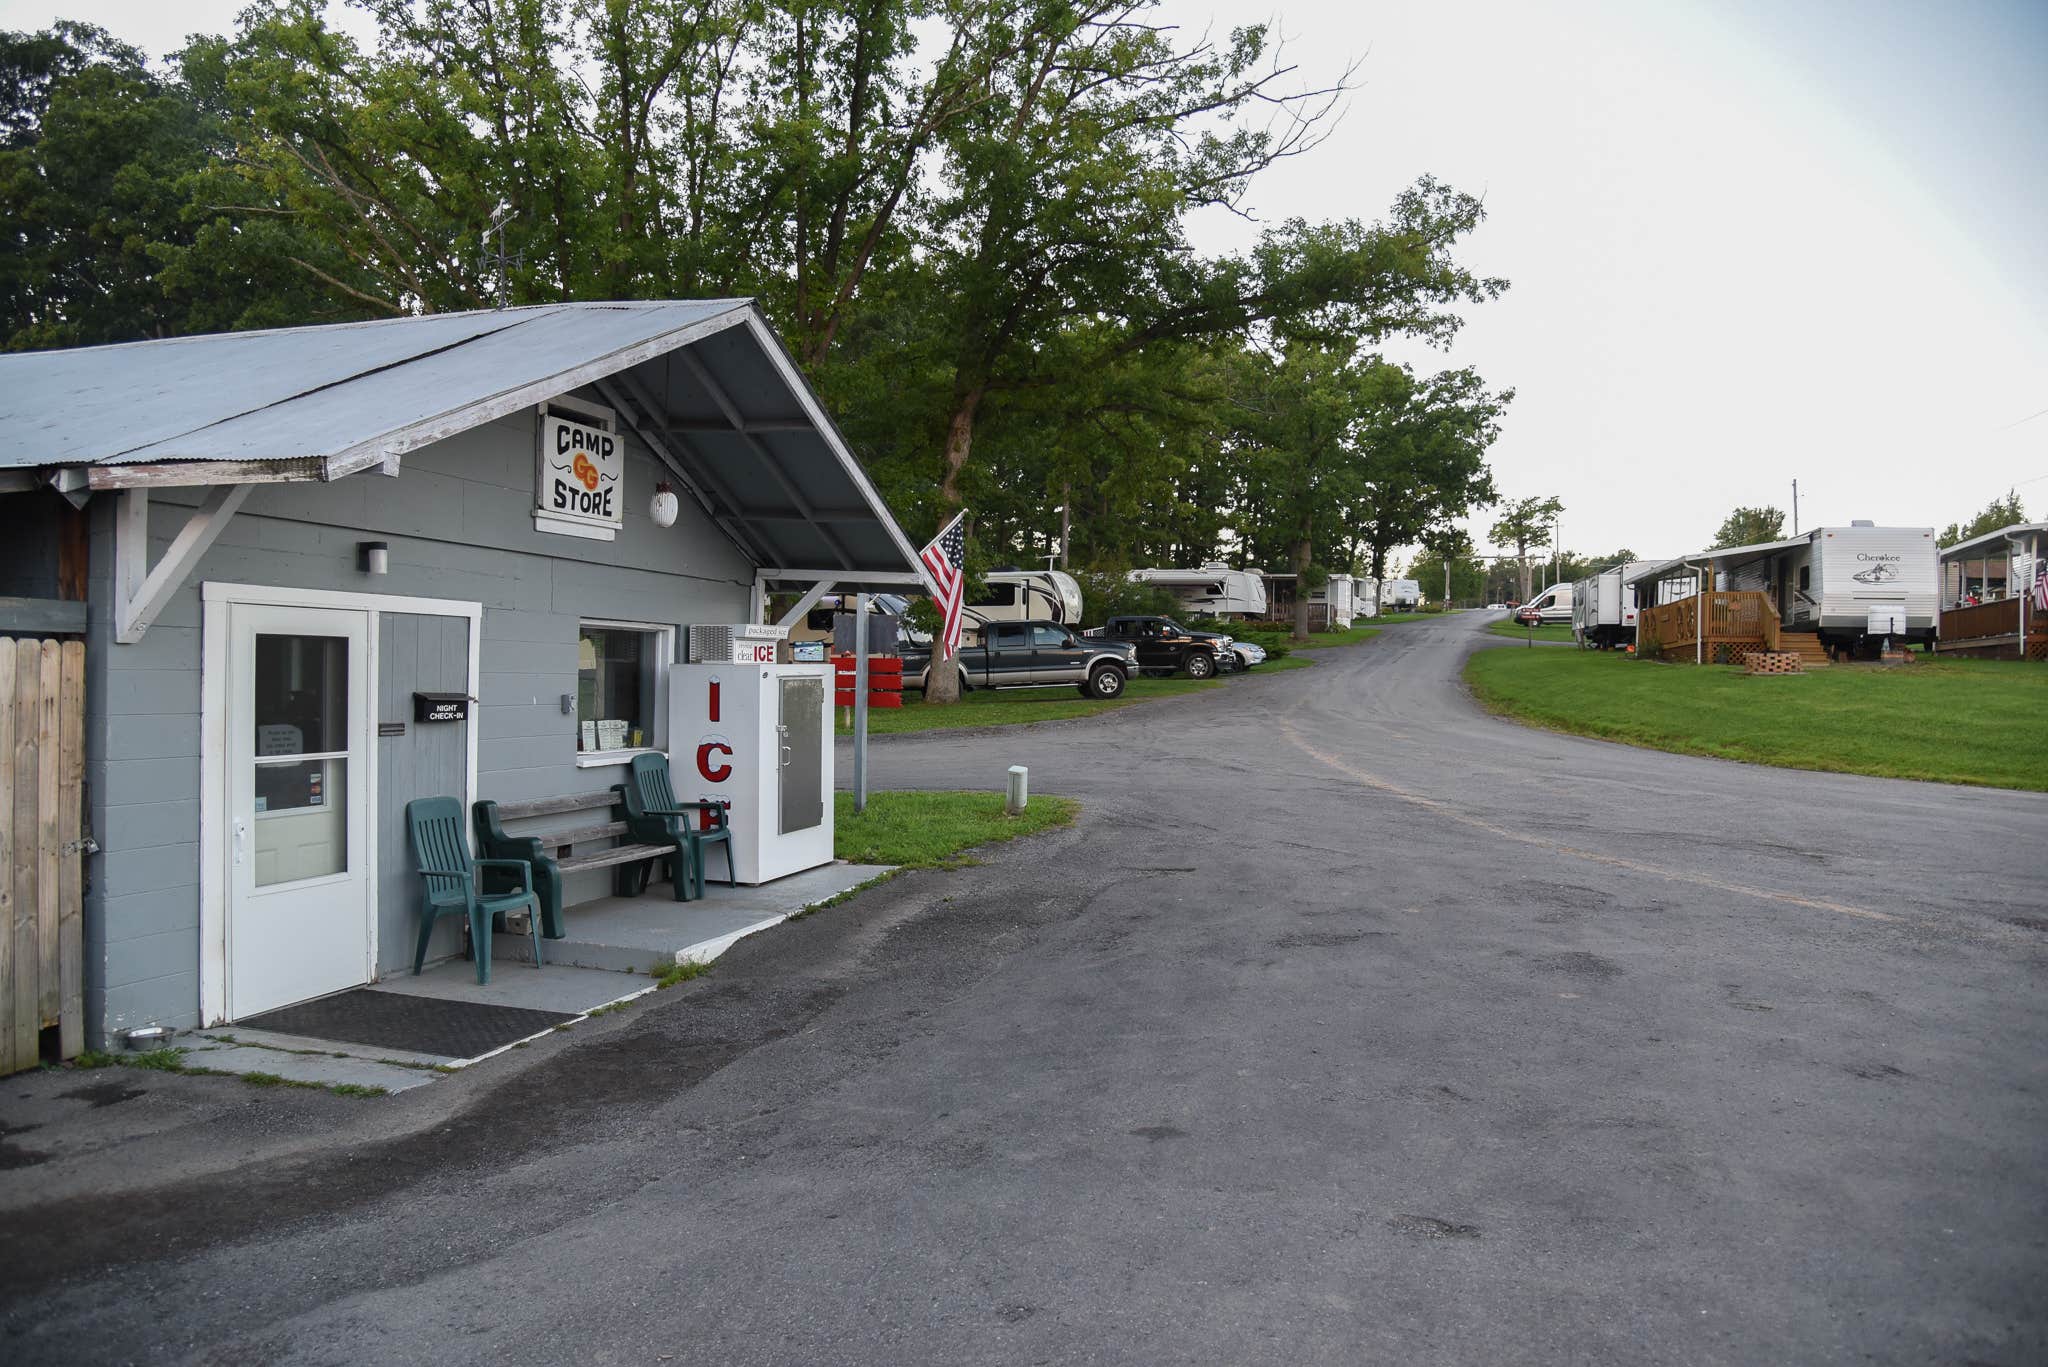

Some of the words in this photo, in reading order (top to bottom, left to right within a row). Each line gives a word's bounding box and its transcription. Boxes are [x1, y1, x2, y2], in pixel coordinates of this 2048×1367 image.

[557, 424, 614, 461] CAMP
[554, 478, 613, 517] STORE
[1856, 553, 1901, 562] Cherokee
[748, 626, 777, 637] packaged
[737, 650, 753, 661] clear
[753, 645, 774, 662] ICE
[436, 704, 458, 712] NIGHT
[429, 712, 464, 720] CHECK-IN
